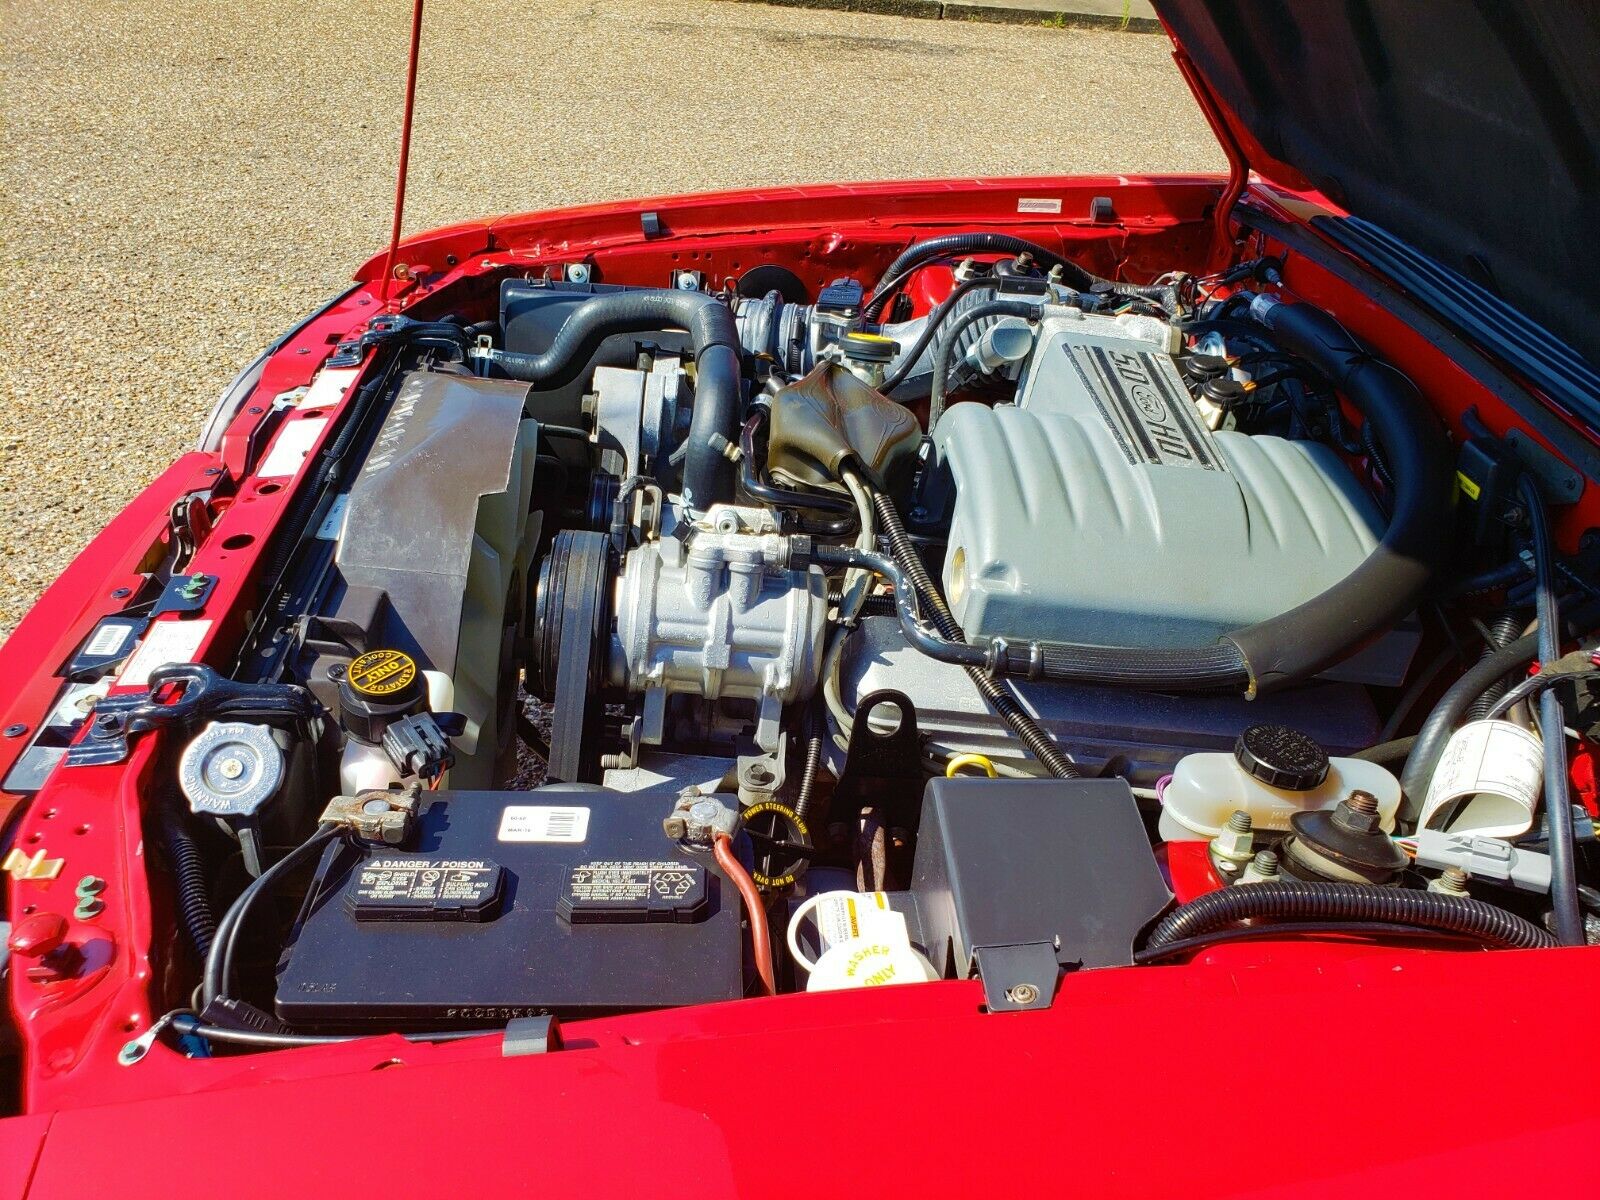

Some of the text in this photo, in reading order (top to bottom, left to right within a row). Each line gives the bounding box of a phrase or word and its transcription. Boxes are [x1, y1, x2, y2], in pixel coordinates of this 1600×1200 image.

[1134, 388, 1163, 419] Ford
[1146, 420, 1193, 460] HO
[353, 652, 392, 674] COOLANT
[367, 661, 400, 682] ONLY
[370, 668, 412, 691] RADIATOR
[186, 775, 232, 810] WARNING
[744, 802, 808, 834] POWER STEERING FLUID
[847, 944, 890, 976] WASHER
[864, 964, 896, 986] ONLY
